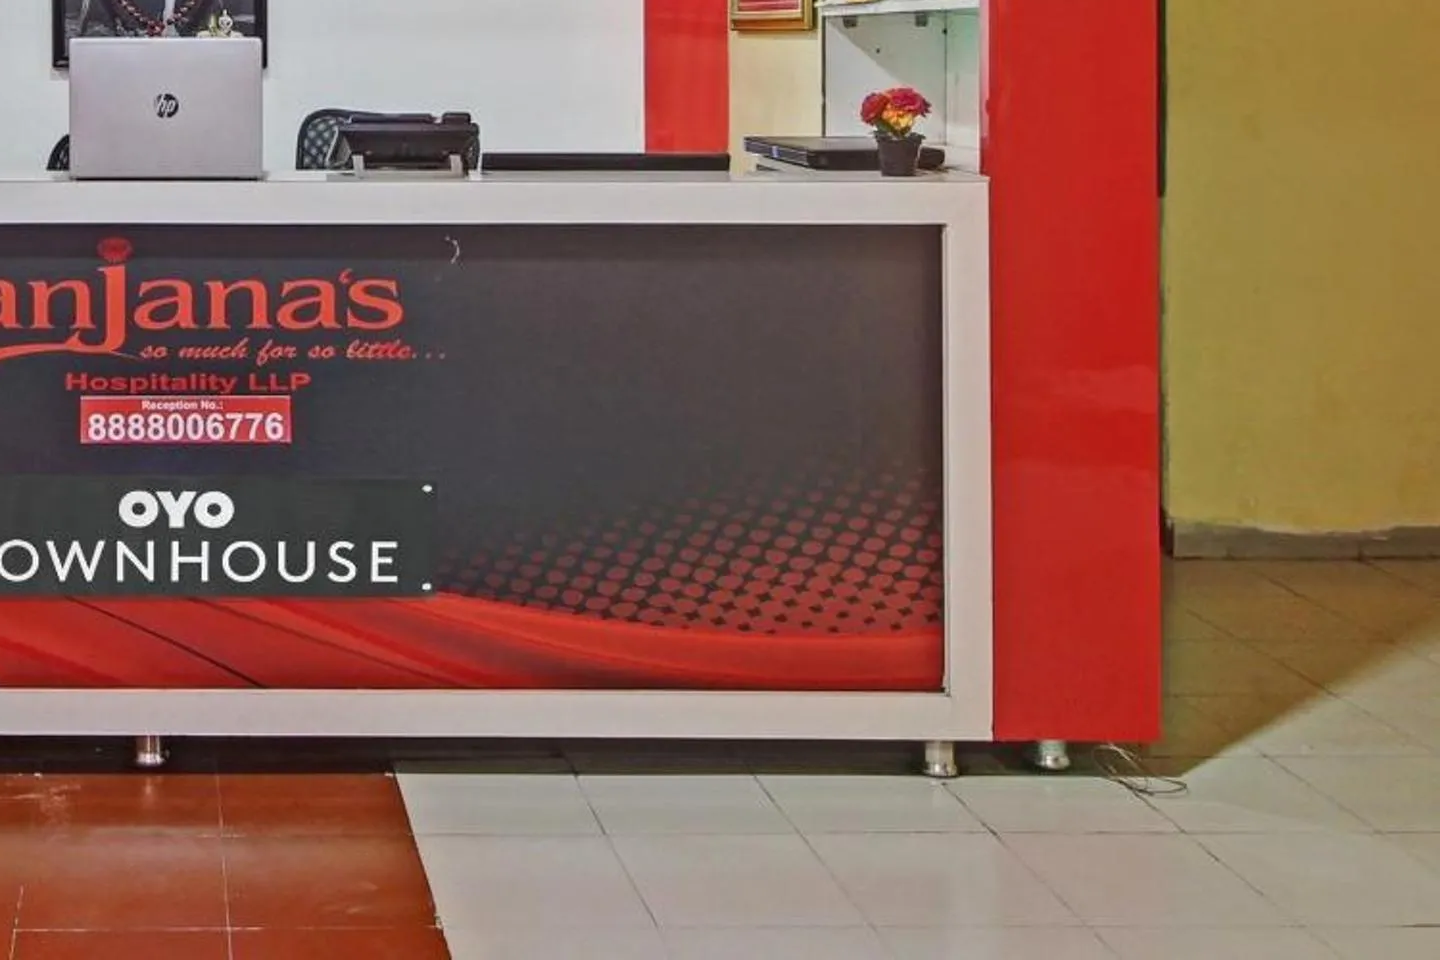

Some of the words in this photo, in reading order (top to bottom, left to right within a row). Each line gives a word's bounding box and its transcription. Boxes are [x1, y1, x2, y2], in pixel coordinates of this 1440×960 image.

[140, 344, 168, 360] so
[178, 339, 250, 359] much
[256, 341, 298, 366] for
[307, 344, 336, 359] so
[65, 372, 237, 394] Hospitality
[248, 372, 312, 392] LLP
[141, 399, 198, 411] Reception
[87, 413, 285, 441] 8888006776
[118, 491, 235, 528] OYO
